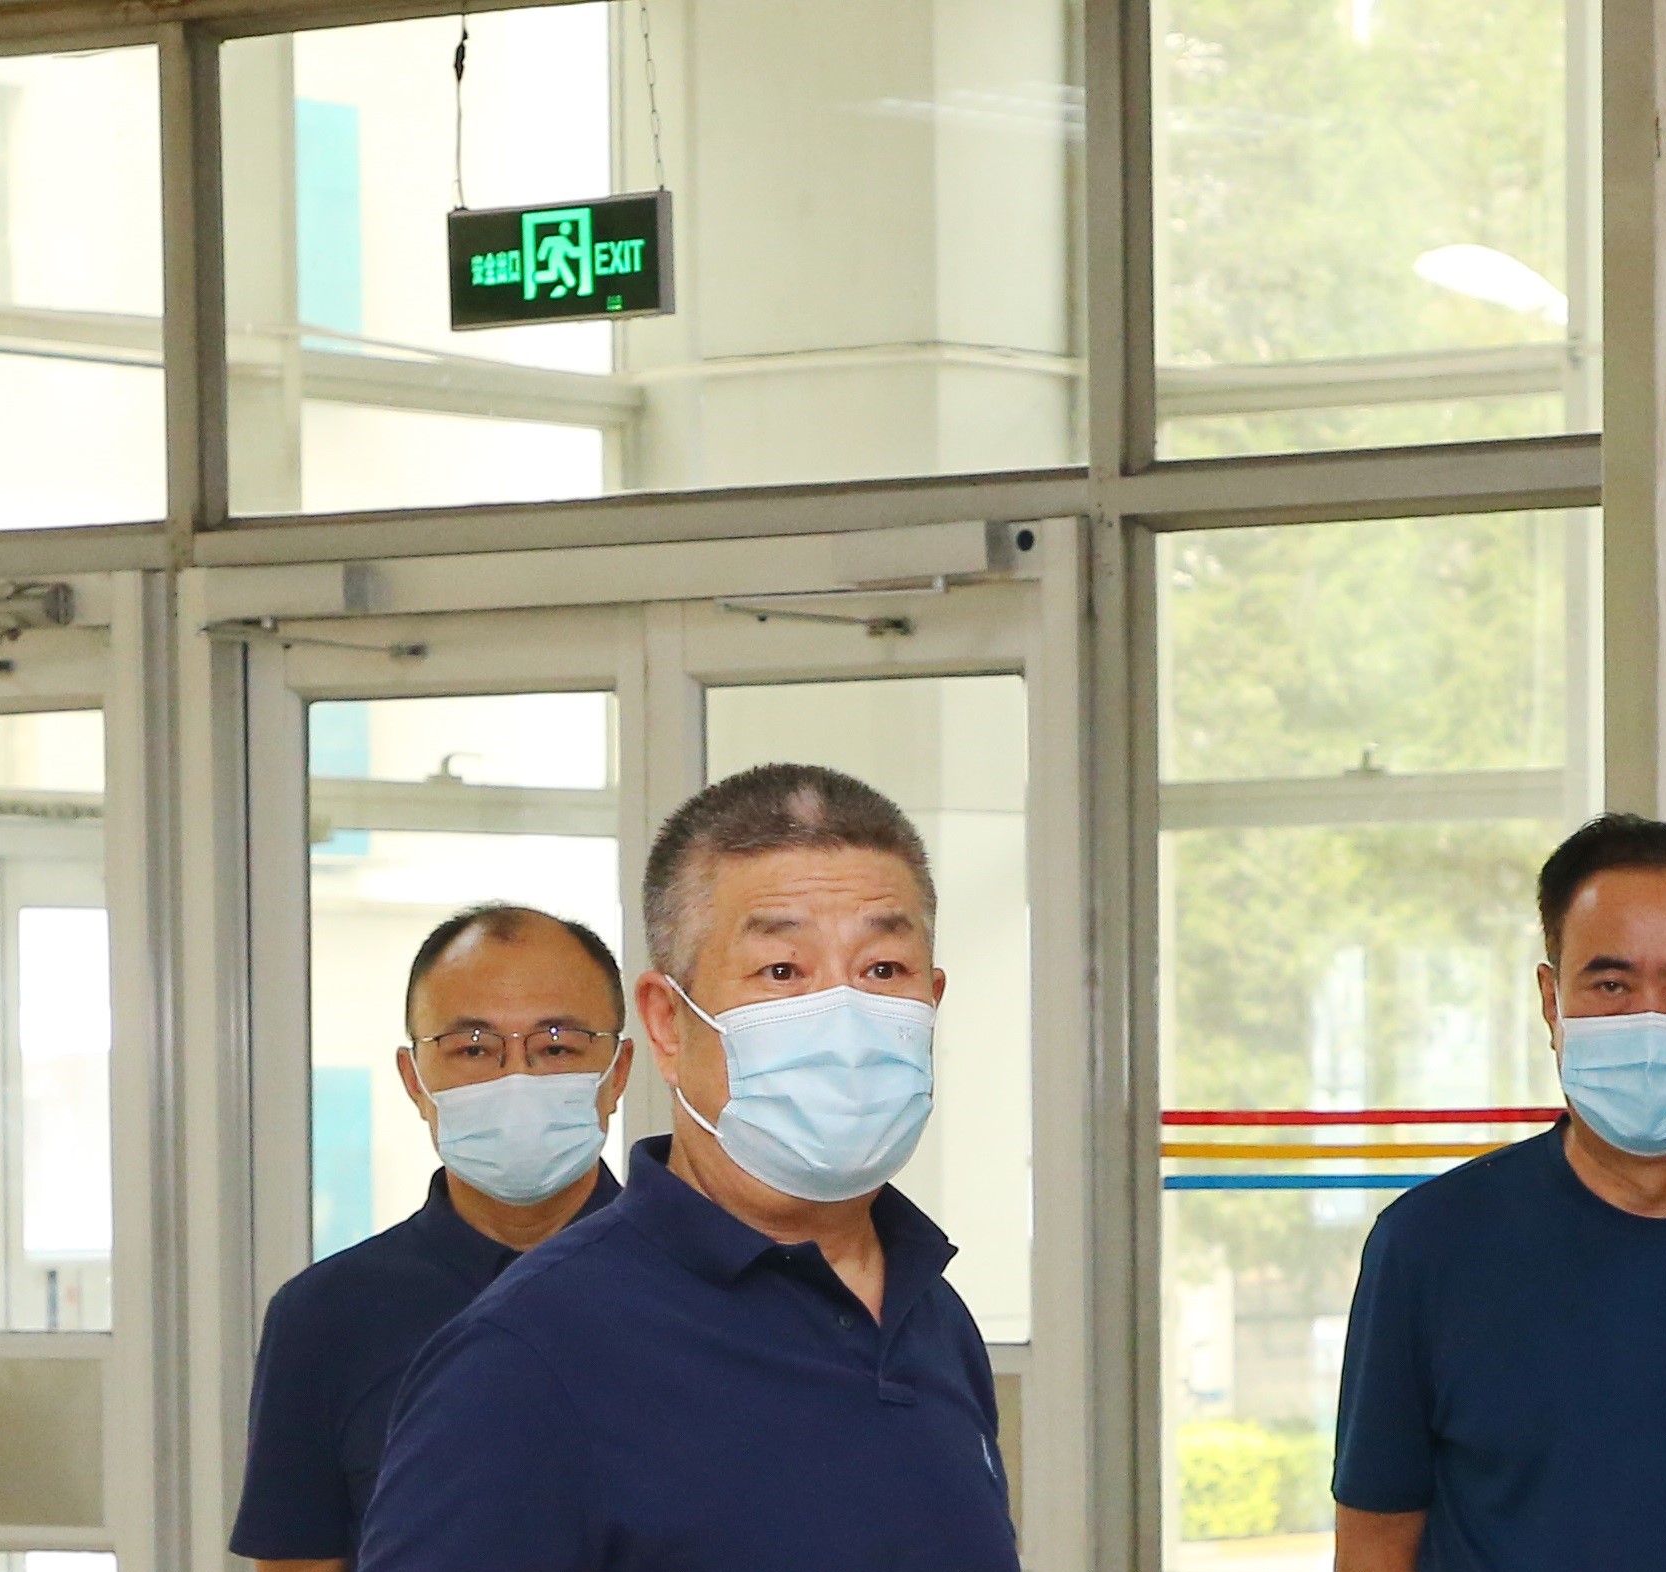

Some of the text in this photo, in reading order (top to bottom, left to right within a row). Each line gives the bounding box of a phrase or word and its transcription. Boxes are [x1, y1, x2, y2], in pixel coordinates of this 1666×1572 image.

[470, 249, 522, 286] 安全出口
[594, 238, 646, 277] EXIT
